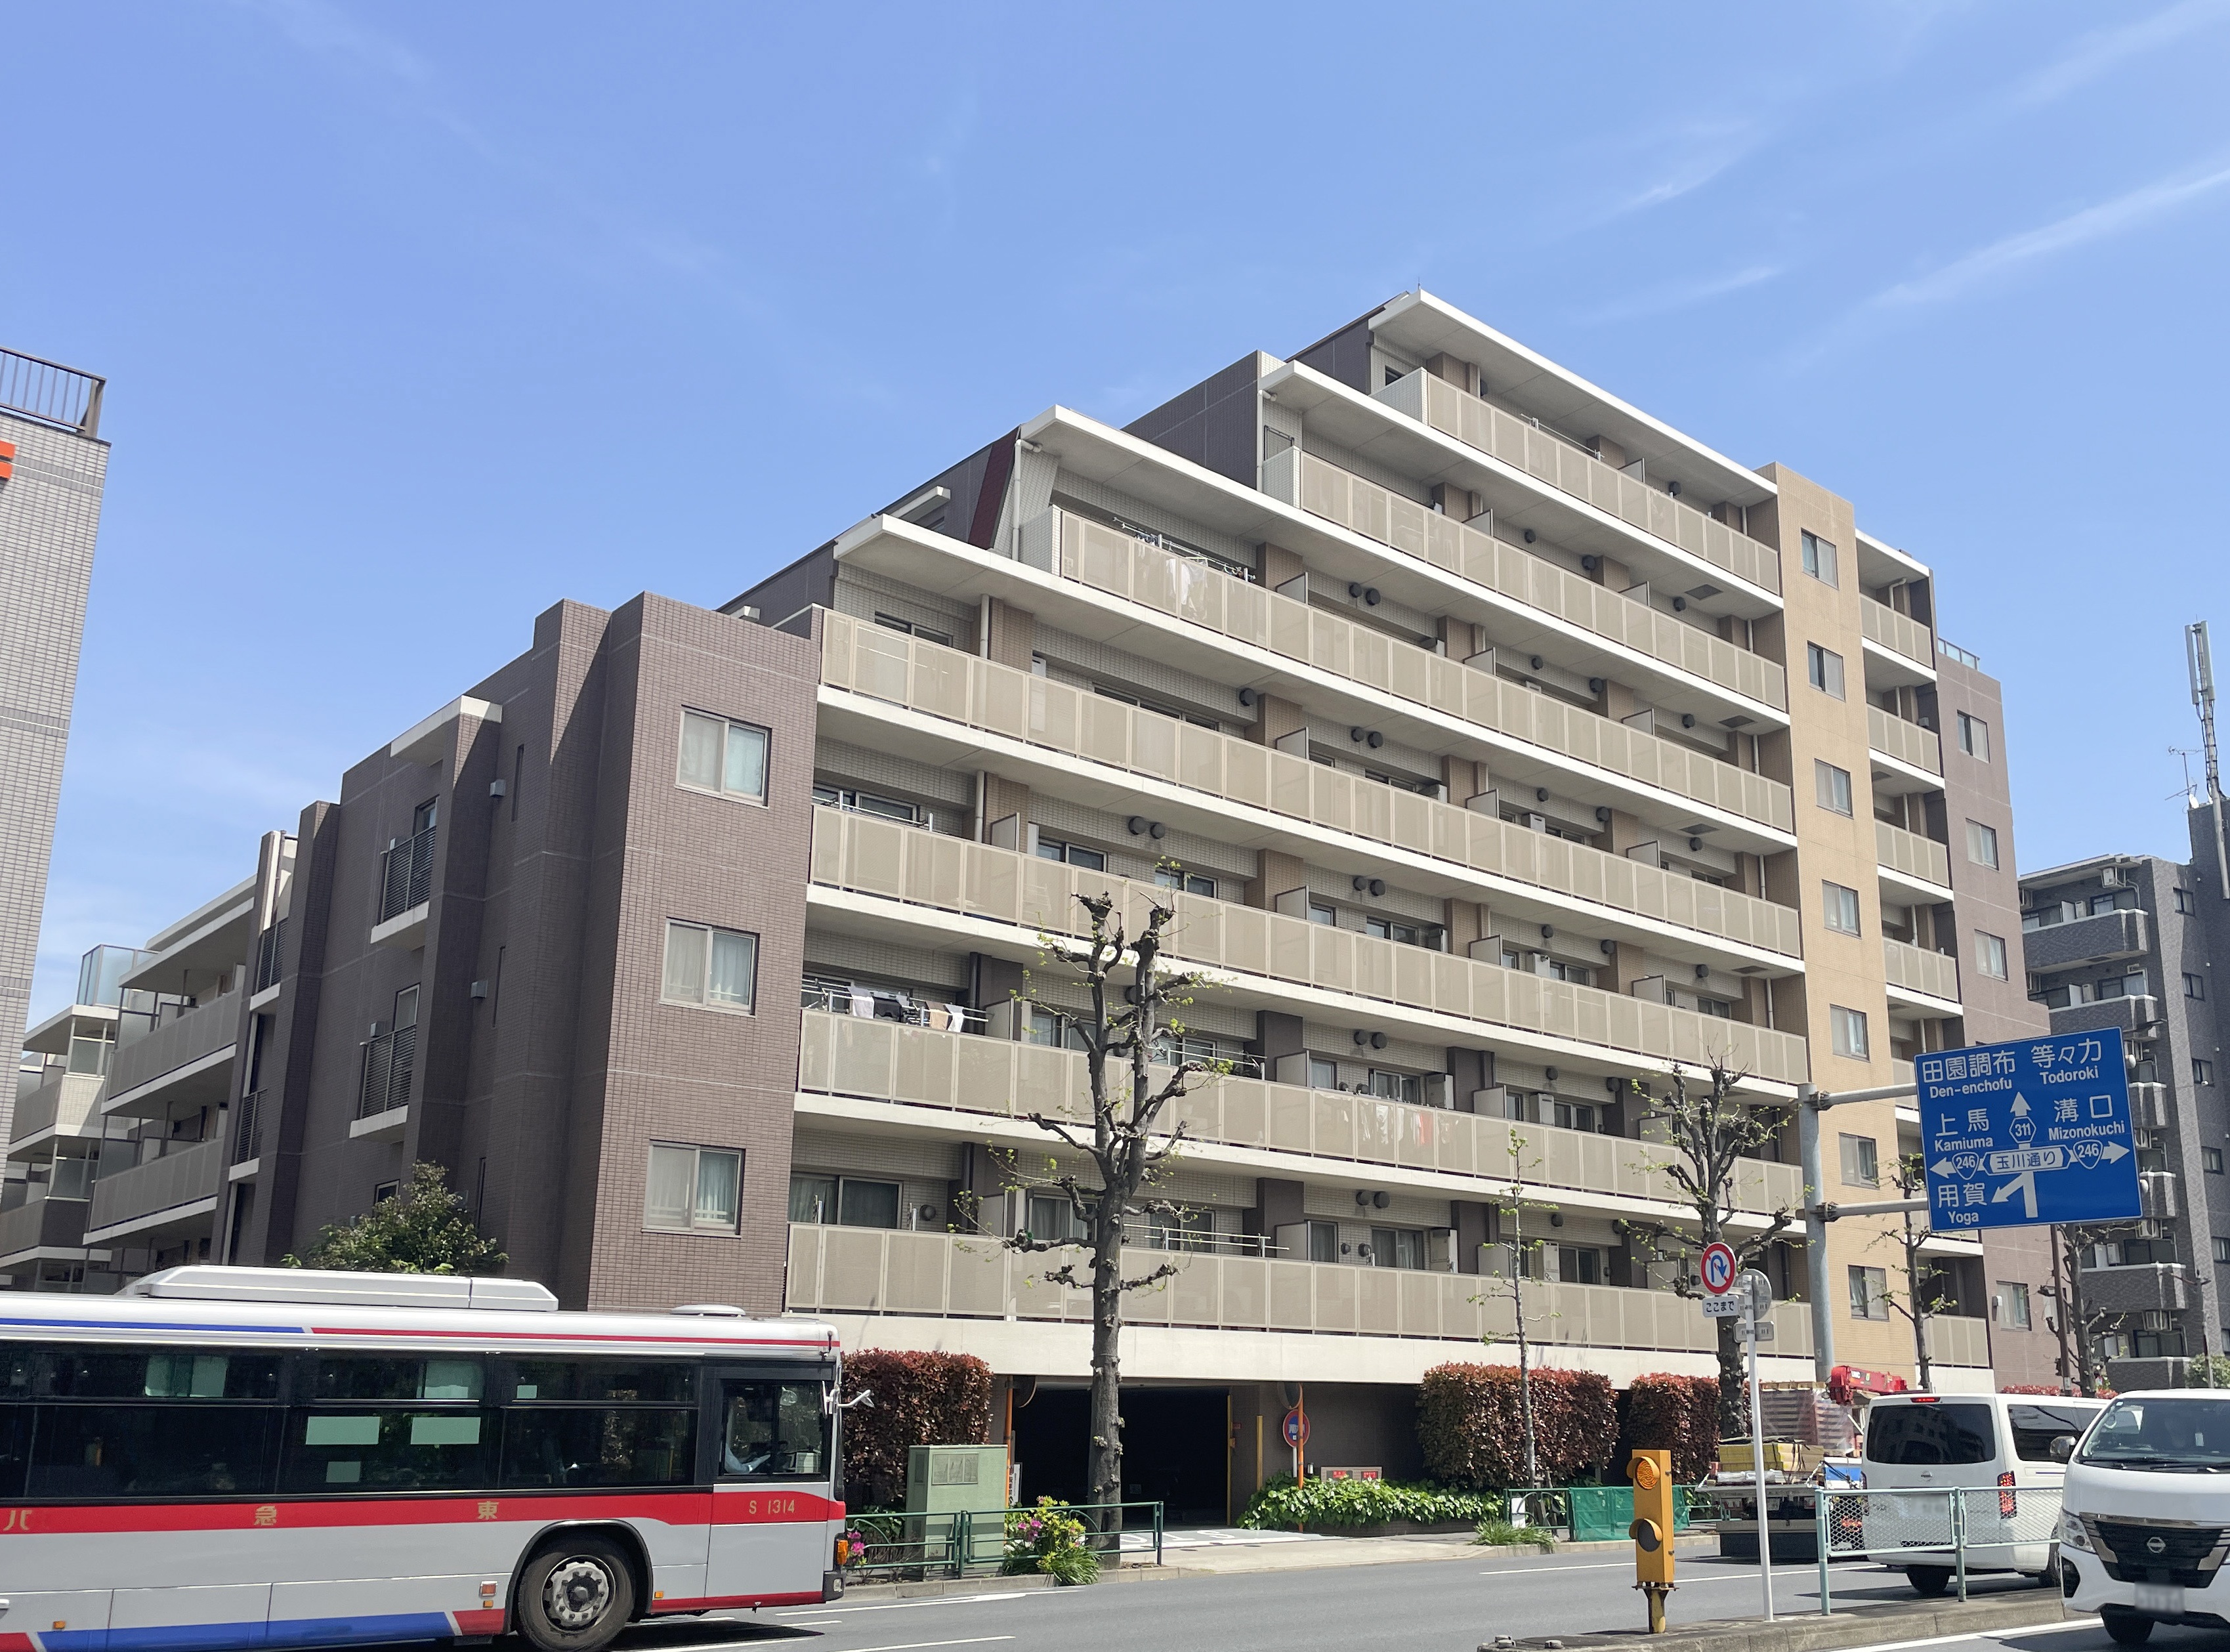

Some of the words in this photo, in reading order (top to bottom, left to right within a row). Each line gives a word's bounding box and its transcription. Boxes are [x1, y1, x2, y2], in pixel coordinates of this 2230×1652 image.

[2030, 1038, 2101, 1069] 等々力
[1922, 1049, 2015, 1083] 田園調布
[2039, 1065, 2099, 1084] Todoroki
[1929, 1077, 2013, 1099] Den-enchofu
[2015, 1122, 2031, 1137] 311
[2048, 1120, 2125, 1141] Mizonokuchi
[1934, 1137, 1994, 1152] Kamiuma
[2077, 1143, 2099, 1158] 246
[1956, 1155, 1976, 1169] 246
[1996, 1151, 2055, 1170] 玉川通り
[1938, 1183, 1987, 1208] 用賀
[1948, 1211, 1979, 1225] Yoga
[1706, 1300, 1735, 1313] ここまで
[254, 1505, 277, 1526] 急
[477, 1500, 499, 1520] 東
[768, 1499, 795, 1514] 1314
